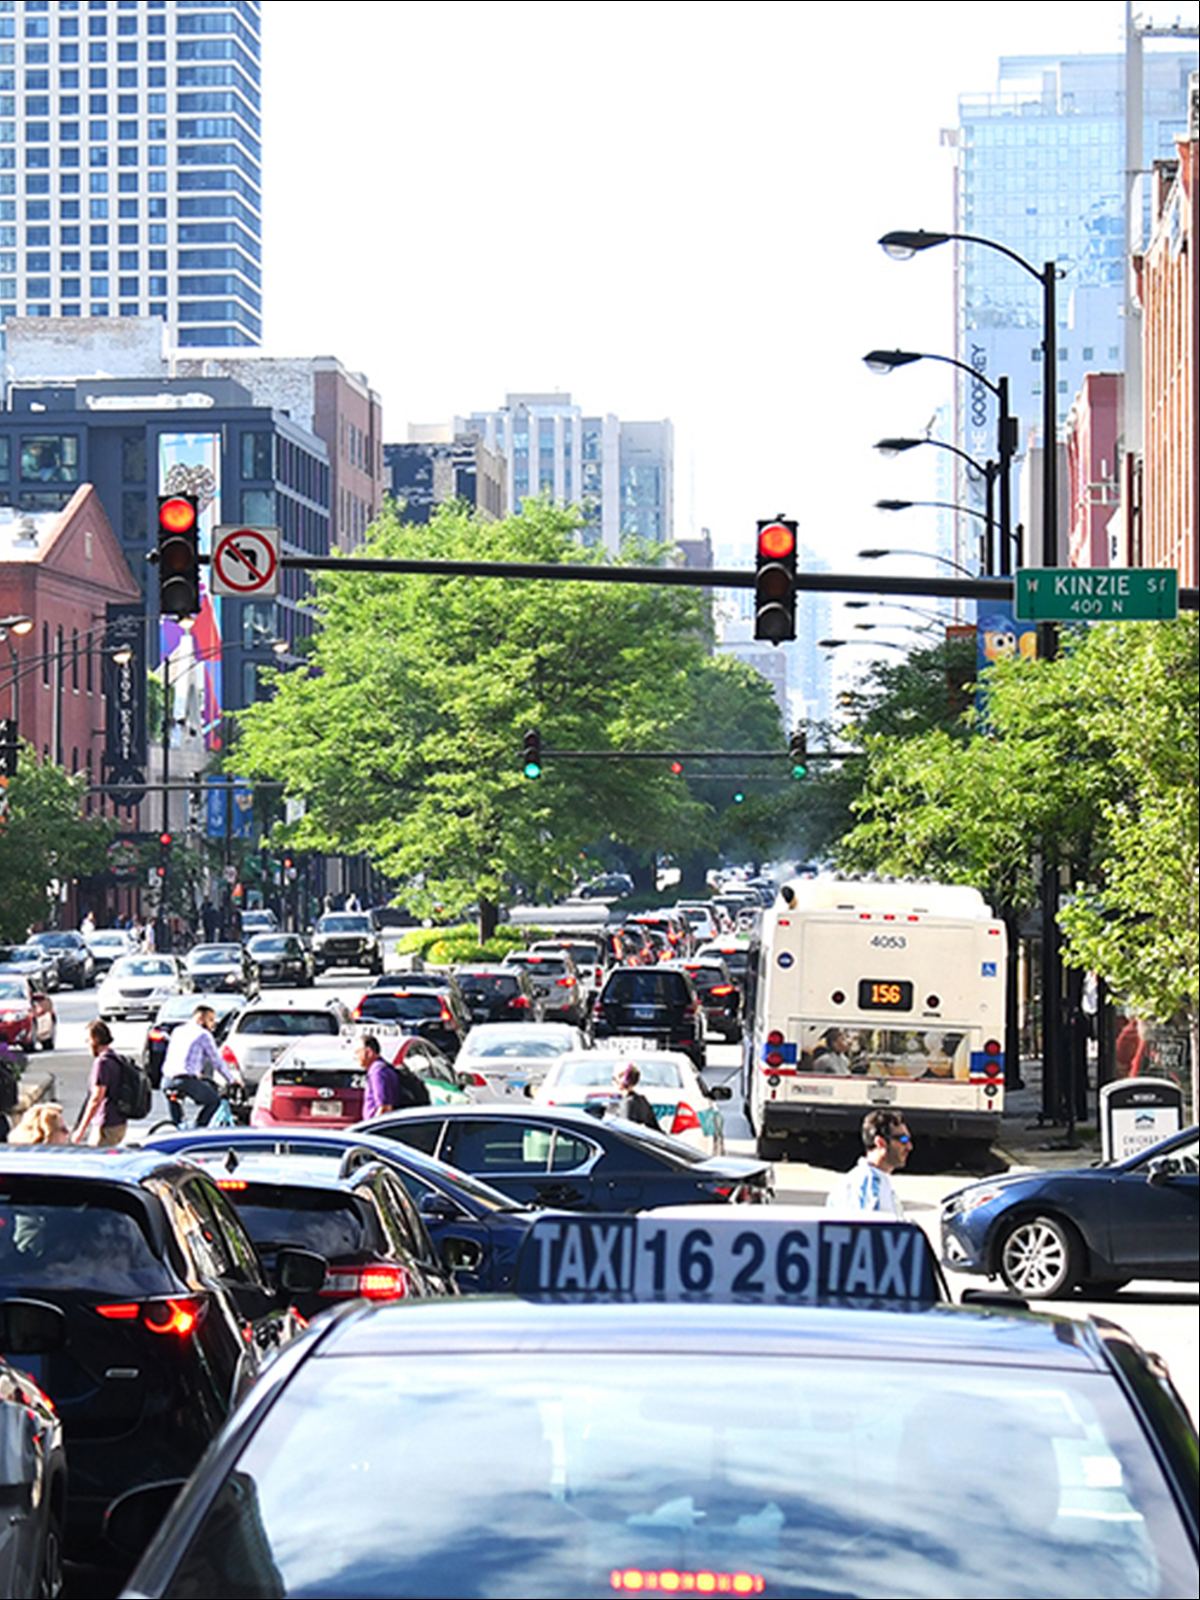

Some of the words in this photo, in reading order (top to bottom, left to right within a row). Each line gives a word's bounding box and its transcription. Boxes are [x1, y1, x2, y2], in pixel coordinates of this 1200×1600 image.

[1026, 578, 1039, 593] W
[1054, 575, 1131, 596] KINZIE
[1070, 599, 1103, 613] 400
[1112, 600, 1123, 613] N
[870, 935, 907, 949] 4053
[871, 983, 902, 1004] 156
[532, 1223, 633, 1291] TAXI
[822, 1227, 926, 1298] TAXI
